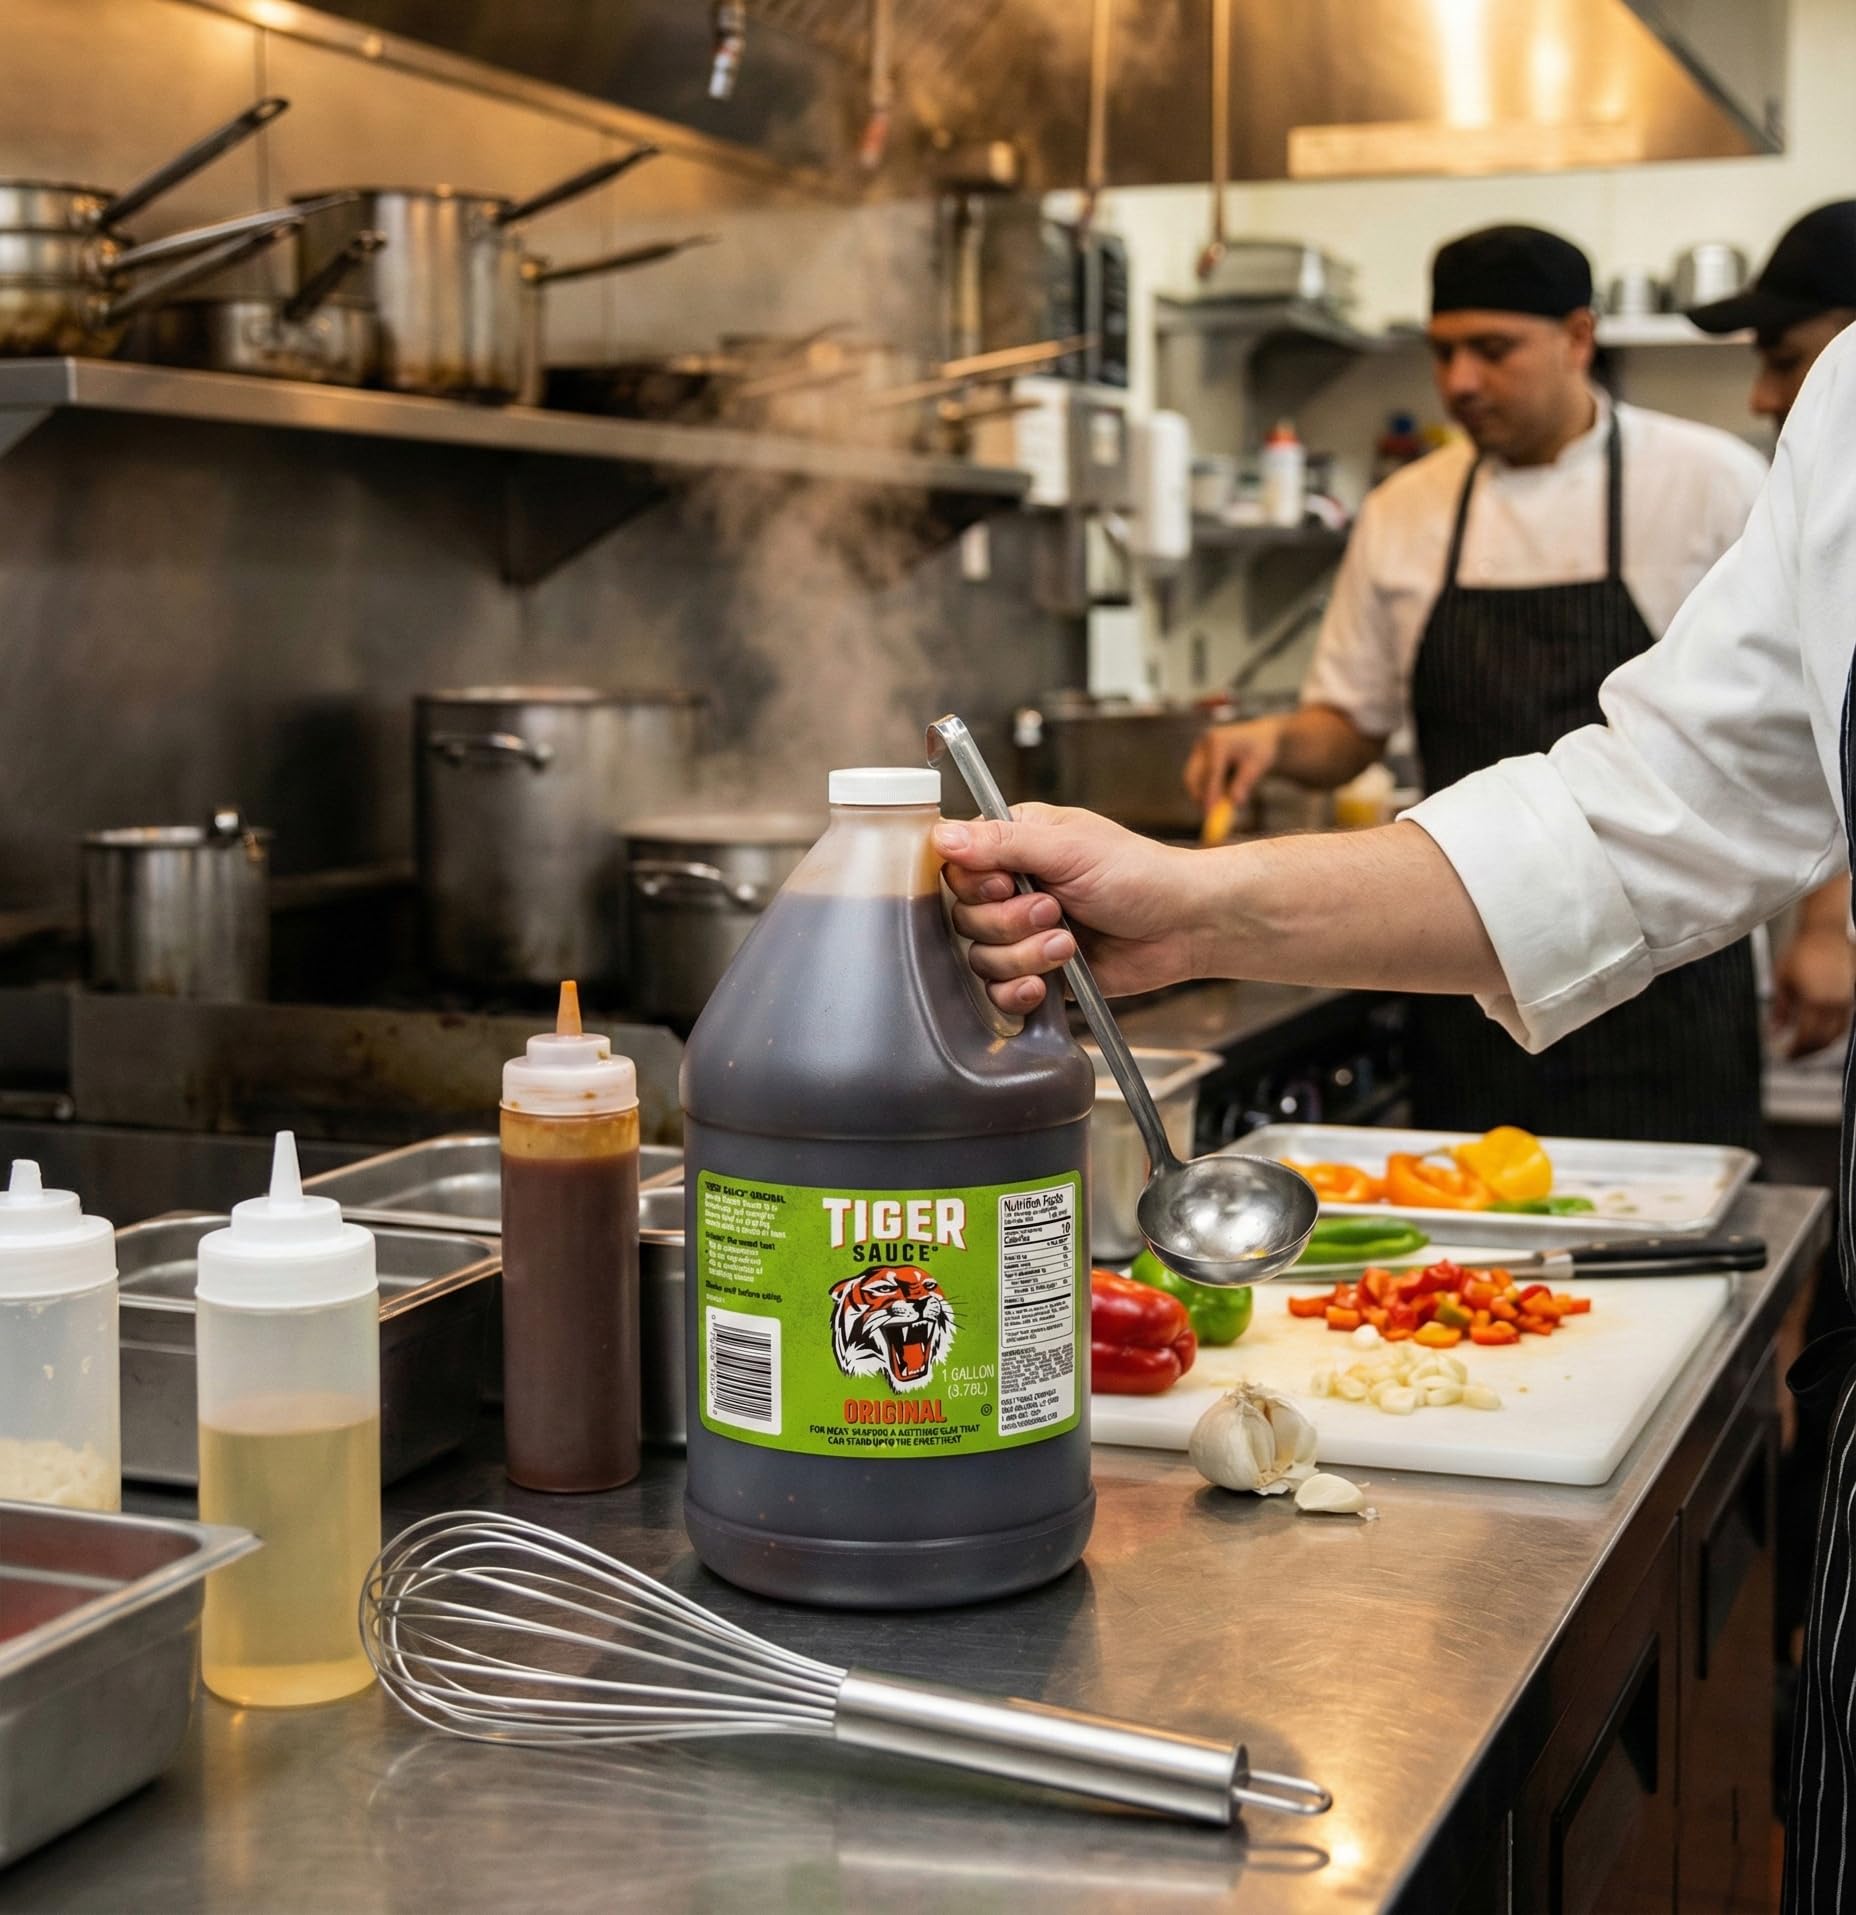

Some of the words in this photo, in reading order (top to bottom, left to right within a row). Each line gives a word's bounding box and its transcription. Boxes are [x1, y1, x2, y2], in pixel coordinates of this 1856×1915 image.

[822, 1197, 968, 1251] TIGER
[942, 1368, 947, 1382] 1
[951, 1364, 995, 1381] GALLON
[844, 1399, 947, 1424] ORIGINAL
[809, 1425, 827, 1434] FOR
[896, 1438, 912, 1446] THE
